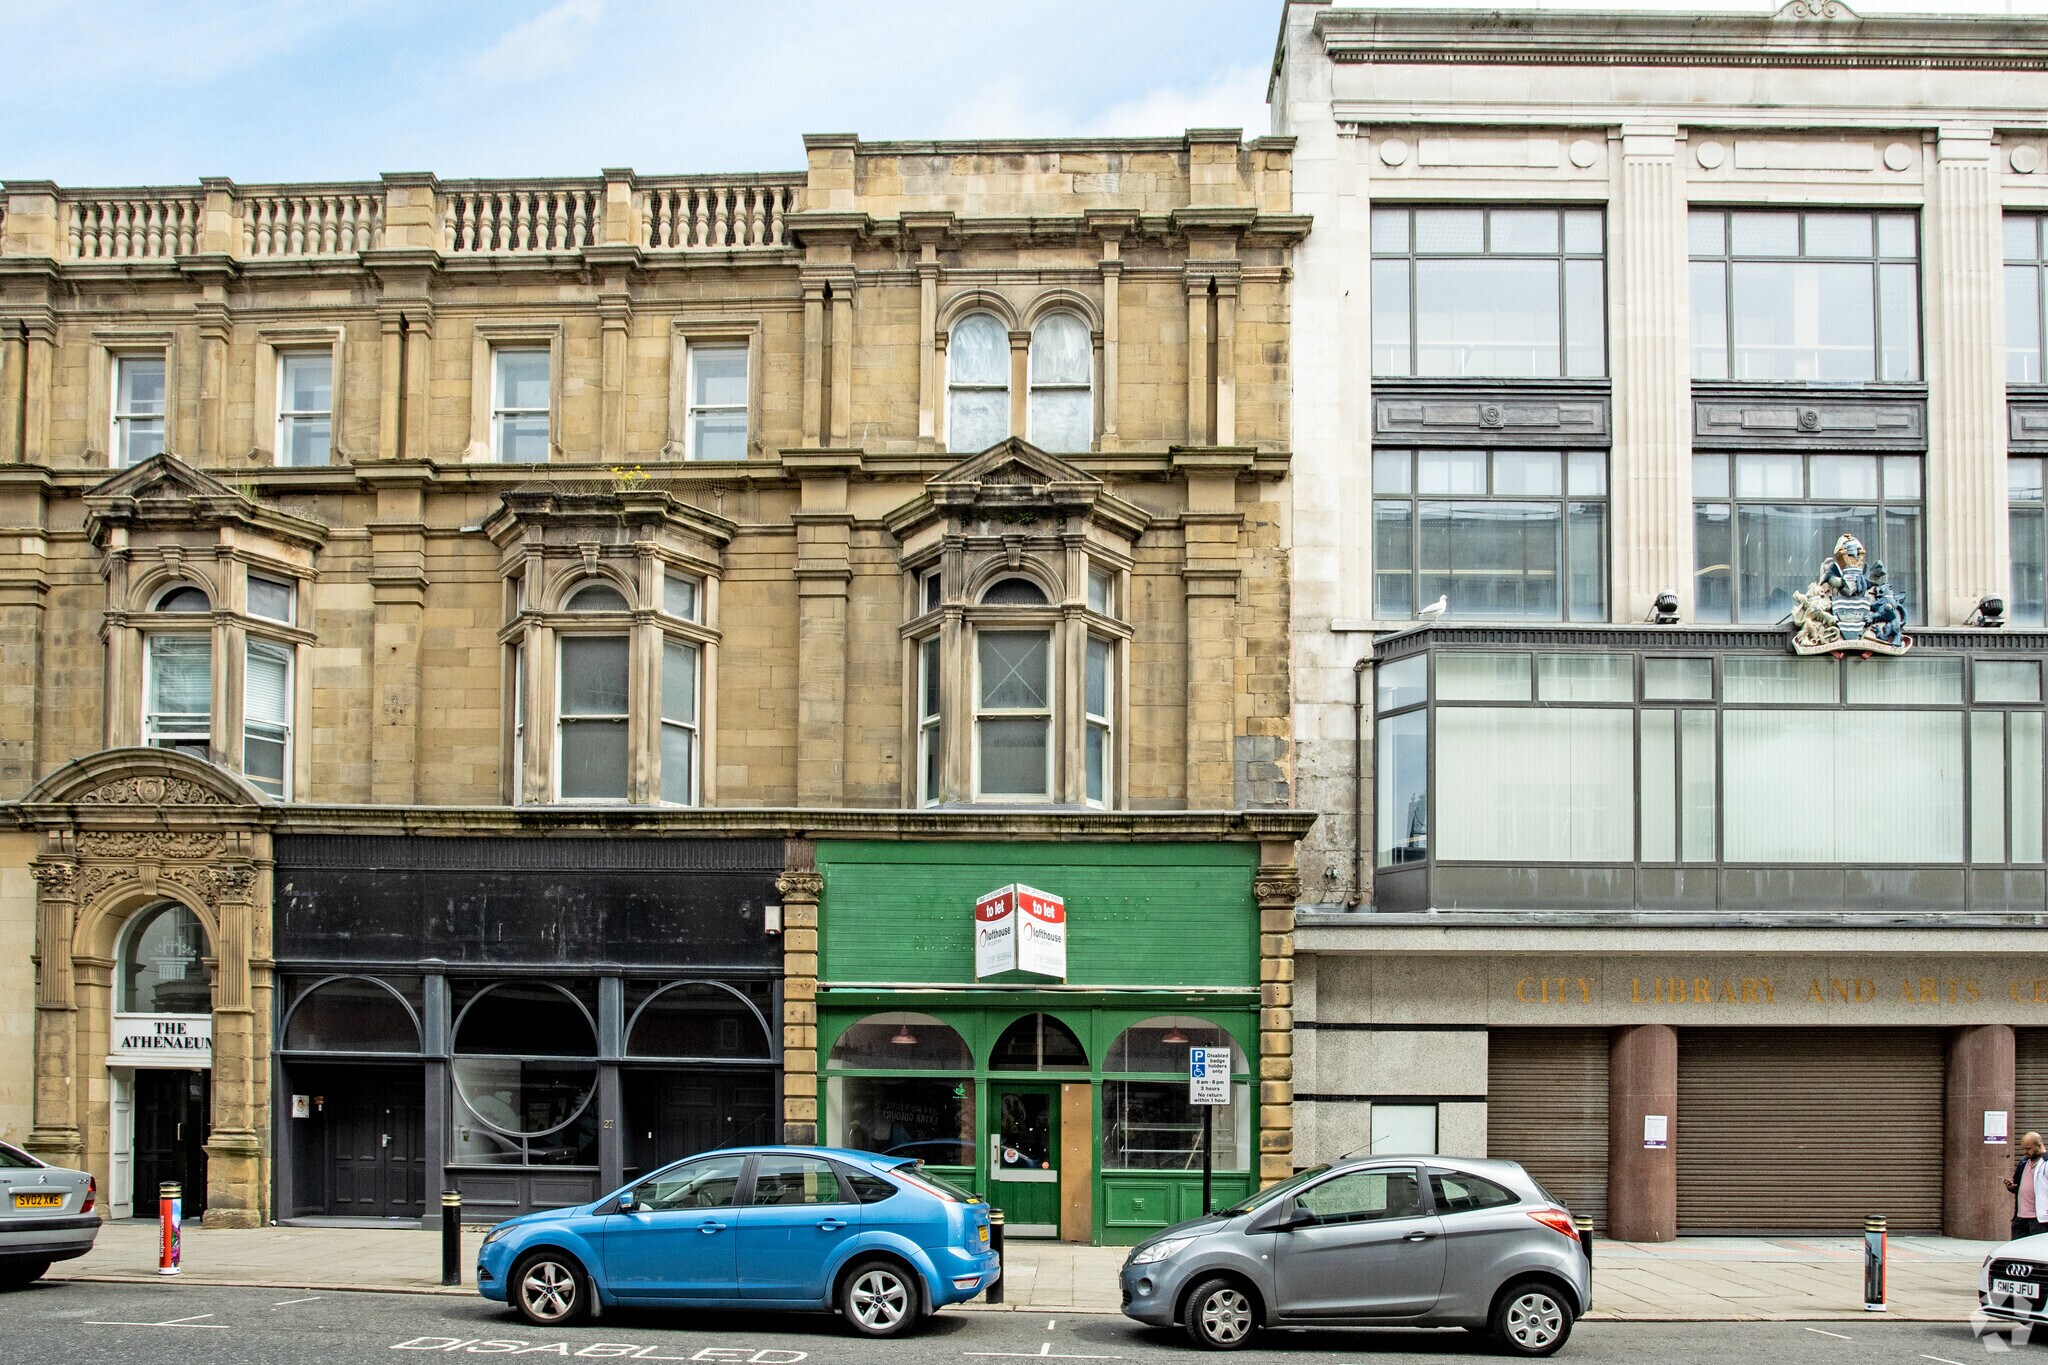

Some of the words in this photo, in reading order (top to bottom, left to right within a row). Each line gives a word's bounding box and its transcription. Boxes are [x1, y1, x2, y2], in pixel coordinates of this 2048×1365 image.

[986, 905, 993, 918] to
[995, 900, 1005, 914] let
[1032, 900, 1041, 915] to
[1044, 904, 1055, 919] let
[1033, 926, 1062, 943] lofthouse
[1515, 977, 1597, 1004] CITY
[1631, 977, 1778, 1004] LIBRARY
[1805, 978, 1876, 1004] AND
[1896, 978, 1981, 1004] ARTS
[154, 1022, 187, 1035] THE
[1195, 1051, 1204, 1061] P
[20, 1194, 42, 1205] SV02
[1997, 1281, 2015, 1293] GM15
[2016, 1284, 2033, 1296] JFU
[389, 1336, 808, 1364] DISABLED
